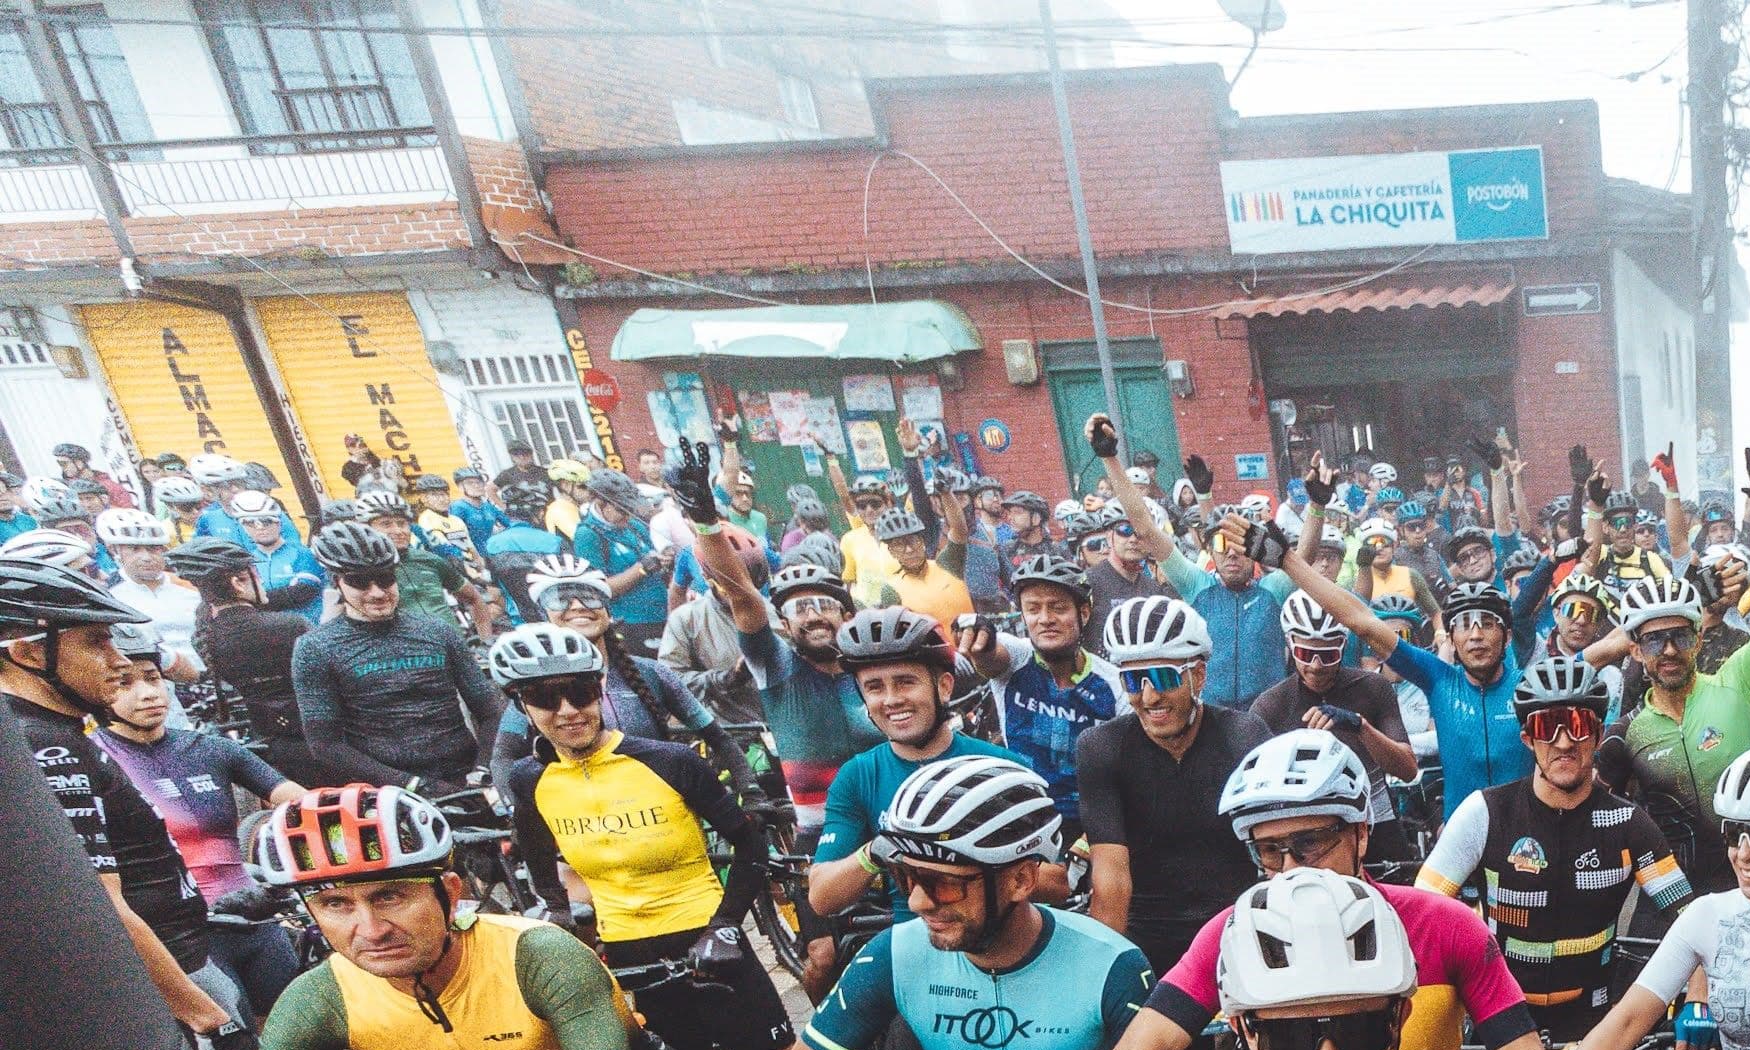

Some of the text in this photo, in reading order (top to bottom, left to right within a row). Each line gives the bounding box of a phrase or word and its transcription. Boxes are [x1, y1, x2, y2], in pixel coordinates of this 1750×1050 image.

[1293, 180, 1444, 201] PANADERÍA Y CAFETERÍA
[1468, 178, 1528, 202] POSTOBÓN
[1296, 200, 1445, 228] LA CHIQUITA
[338, 314, 378, 358] EL
[281, 393, 324, 494] HIERRO
[354, 653, 447, 678] SPECIALIZED
[928, 983, 979, 1000] HIGHFORCE
[1036, 1026, 1071, 1035] BIKES
